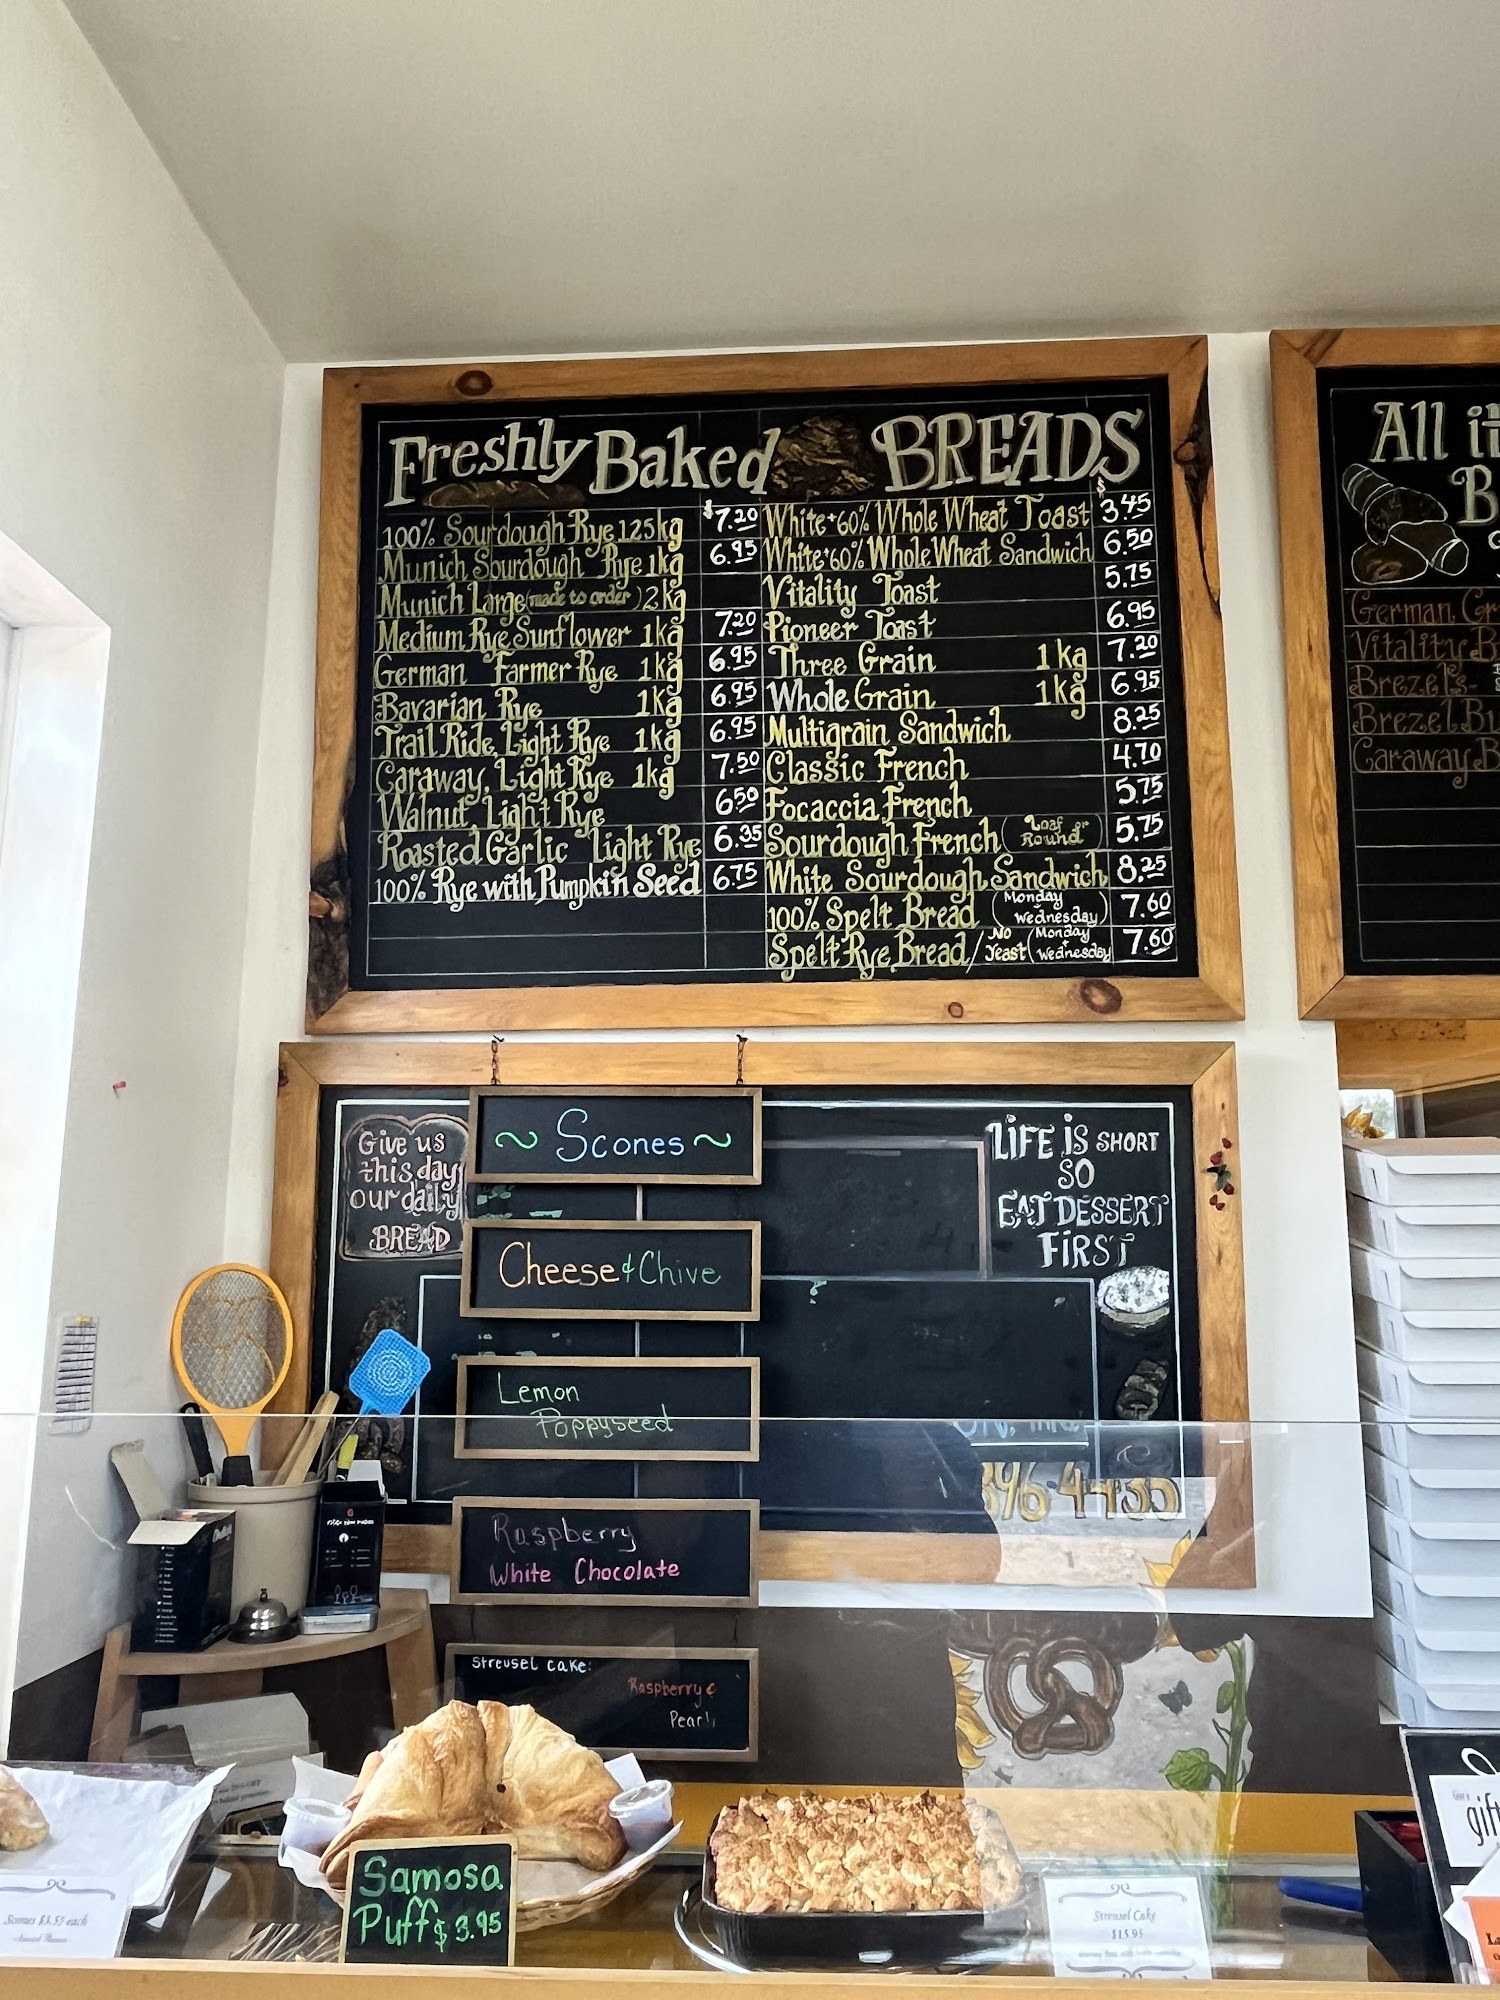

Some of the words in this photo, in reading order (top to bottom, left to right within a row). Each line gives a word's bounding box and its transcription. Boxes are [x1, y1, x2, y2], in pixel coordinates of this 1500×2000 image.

[1369, 400, 1449, 463] All
[385, 419, 592, 507] Freshly
[589, 424, 781, 495] Baked
[872, 409, 1144, 493] BREADS
[383, 516, 435, 549] 100%
[444, 512, 564, 556] Sourdough
[569, 509, 614, 556] Rye
[876, 497, 937, 535] Whole
[944, 495, 1009, 533] Wheat
[1014, 494, 1091, 532] Toast
[379, 550, 468, 583] Munich
[473, 548, 584, 592] Sourdough
[599, 545, 642, 590] Rye
[710, 540, 758, 565] 6.95
[867, 536, 931, 569] Whole
[931, 534, 992, 567] Wheat
[999, 532, 1094, 565] Sandwich
[1104, 528, 1153, 555] 6.50
[378, 583, 462, 617] Munich
[471, 582, 527, 625] Large
[569, 590, 587, 605] to
[762, 573, 858, 618] Vitality
[872, 571, 940, 607] Toast
[1105, 562, 1152, 589] 5.75
[1351, 589, 1455, 625] German
[378, 618, 467, 652] Medium
[468, 609, 509, 663] Rye
[512, 611, 632, 650] Sunflower
[715, 611, 756, 637] 7.20
[763, 610, 858, 643] Pioneer
[865, 607, 936, 640] Toast
[1107, 600, 1155, 629] 6.95
[373, 655, 468, 689] German
[490, 651, 572, 685] Farmer
[576, 649, 618, 693] Rye
[708, 645, 757, 673] 6.95
[767, 643, 847, 678] Three
[858, 640, 936, 674] Grain
[1107, 633, 1158, 661] 7.20
[1350, 628, 1467, 676] Vitality
[374, 691, 487, 722] Bavarian
[498, 687, 542, 732] Rye
[711, 681, 757, 709] 6.95
[766, 676, 850, 713] Whole
[854, 673, 936, 710] Grain
[1111, 669, 1161, 695] 6.95
[764, 714, 891, 758] Multigrain
[898, 706, 1011, 744] Sandwich
[1113, 703, 1161, 733] 8.25
[1352, 698, 1458, 734] Brezel
[374, 722, 438, 759] Trail
[501, 721, 563, 767] Light
[566, 717, 611, 765] Rye
[710, 715, 757, 743] 6.95
[766, 747, 864, 784] Classic
[874, 746, 969, 783] French
[1113, 742, 1162, 769] 4.70
[1353, 737, 1471, 789] Caraway
[495, 757, 564, 803] Light
[566, 755, 615, 803] Rye
[711, 751, 760, 780] 7.50
[765, 786, 884, 822] Focaccia
[882, 780, 972, 821] French
[1115, 775, 1163, 805] 5.75
[482, 789, 551, 843] Light
[555, 790, 606, 839] Rye
[716, 786, 760, 815] 6.50
[377, 830, 483, 872] Roasted
[486, 828, 568, 863] Garlic
[589, 825, 652, 878] Light
[662, 824, 702, 873] Rye
[714, 824, 763, 853] 6.35
[765, 823, 909, 868] Sourdough
[910, 817, 1003, 855] French
[1116, 813, 1163, 843] 5.75
[373, 870, 427, 904] 100%
[431, 864, 478, 913] Rye
[483, 866, 536, 901] with
[535, 863, 629, 911] Pumpkin
[632, 860, 702, 897] Seed
[713, 862, 757, 891] 6.75
[765, 860, 833, 894] White
[846, 857, 987, 903] Sourdough
[991, 851, 1108, 890] Sandwich
[1117, 854, 1166, 883] 8.25
[767, 896, 819, 932] 100%
[826, 898, 893, 940] Spelt
[901, 892, 979, 929] Bread
[1120, 892, 1171, 919] 7.60
[769, 932, 841, 982] Spelt
[840, 931, 891, 979] Rye
[1123, 928, 1174, 955] 7.60
[358, 1130, 406, 1156] Give
[415, 1130, 445, 1154] us
[555, 1108, 684, 1162] Scones
[1096, 1131, 1159, 1152] SHORT
[360, 1157, 412, 1184] this
[417, 1160, 460, 1188] day
[1058, 1158, 1095, 1189] SO
[350, 1188, 397, 1211] our
[401, 1182, 461, 1220] daily
[998, 1190, 1052, 1228] EAT
[1053, 1194, 1169, 1227] DESSERT
[370, 1223, 450, 1253] BREAD
[500, 1242, 619, 1288] Cheese
[639, 1250, 721, 1286] Chive
[497, 1372, 580, 1405] Lemon
[530, 1404, 673, 1438] Poppyseed
[493, 1512, 637, 1553] Raspberry
[489, 1563, 551, 1587] White
[574, 1558, 681, 1584] Chocolate
[628, 1677, 702, 1708] Raspberry
[359, 1856, 503, 1897] Samosa
[353, 1896, 438, 1946] Puff
